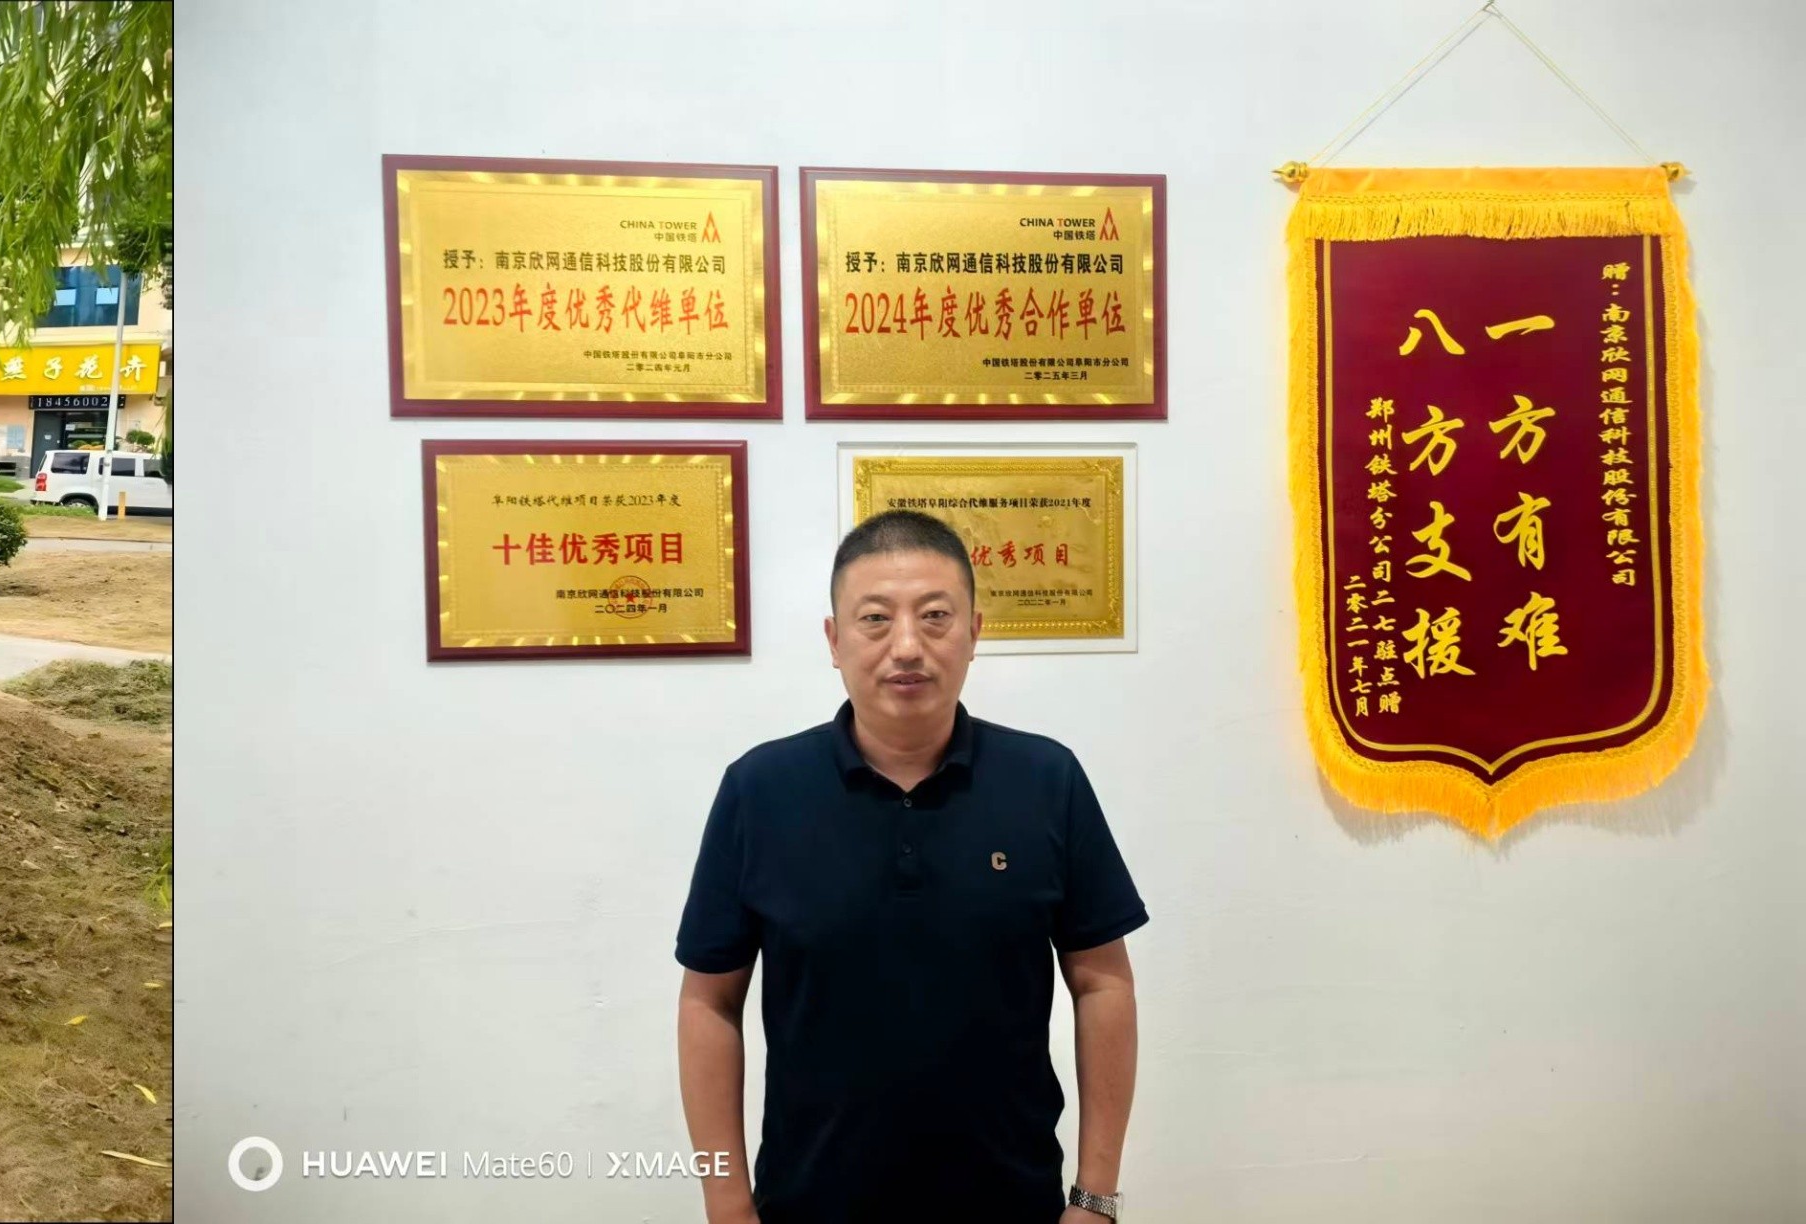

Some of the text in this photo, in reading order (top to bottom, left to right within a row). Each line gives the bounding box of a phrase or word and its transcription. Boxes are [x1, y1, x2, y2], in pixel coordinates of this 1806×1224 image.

[620, 219, 698, 231] CHINA TOWER
[654, 231, 698, 243] 中国铁塔
[1020, 217, 1096, 229] CHINA TOWER
[1053, 229, 1096, 241] 中国铁塔
[443, 281, 729, 334] 2023年度优秀代维单位
[845, 284, 1127, 341] 2024年度优秀合作单位
[0, 354, 148, 383] 燕子花卉
[982, 357, 1130, 368] 中国铁塔股份有限公司阜阳市分公司
[1024, 370, 1088, 381] 二零二五年三月
[1398, 308, 1476, 681] 八方支援
[1484, 313, 1569, 672] 一方有难
[492, 532, 685, 566] 十佳优秀项目
[971, 541, 1069, 568] 优秀项目
[1343, 575, 1373, 717] 二零二一年七月
